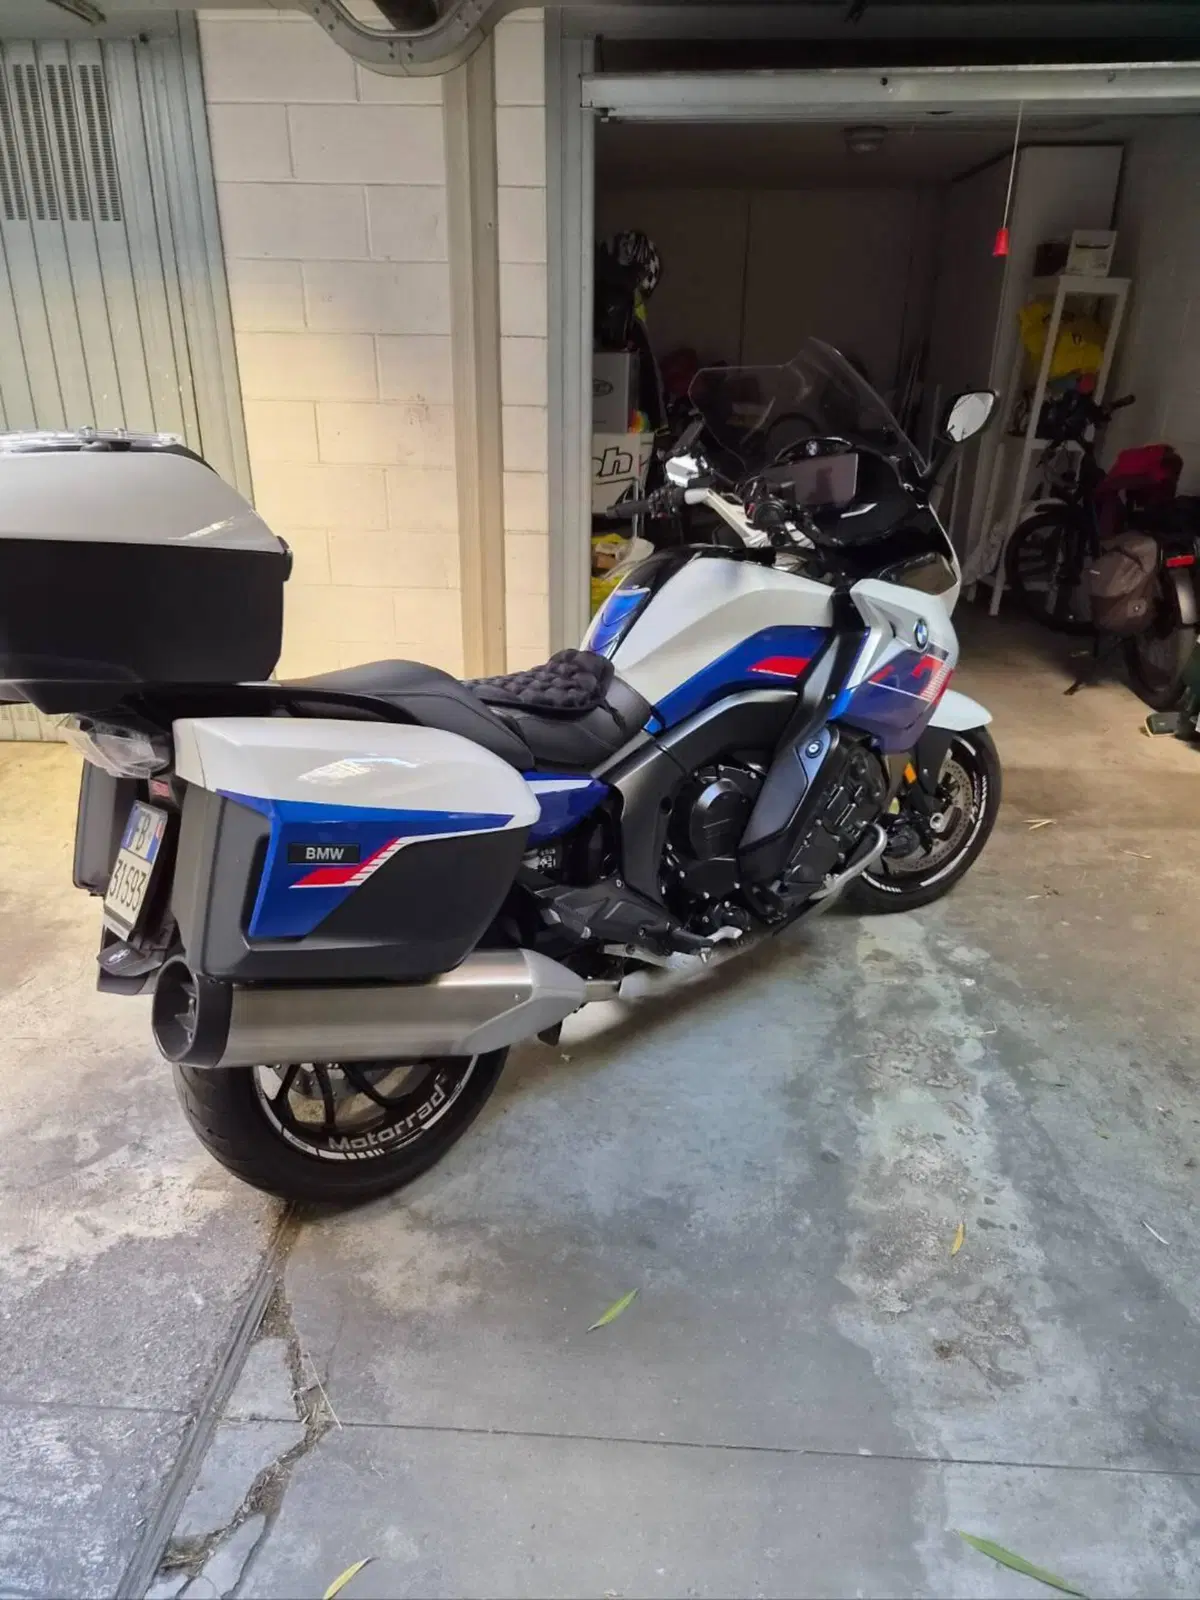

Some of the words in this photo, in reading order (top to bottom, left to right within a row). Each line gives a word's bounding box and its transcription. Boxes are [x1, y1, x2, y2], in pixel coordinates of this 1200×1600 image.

[305, 847, 345, 860] BMW
[109, 859, 147, 911] 31593
[328, 1083, 446, 1150] Motorrad
